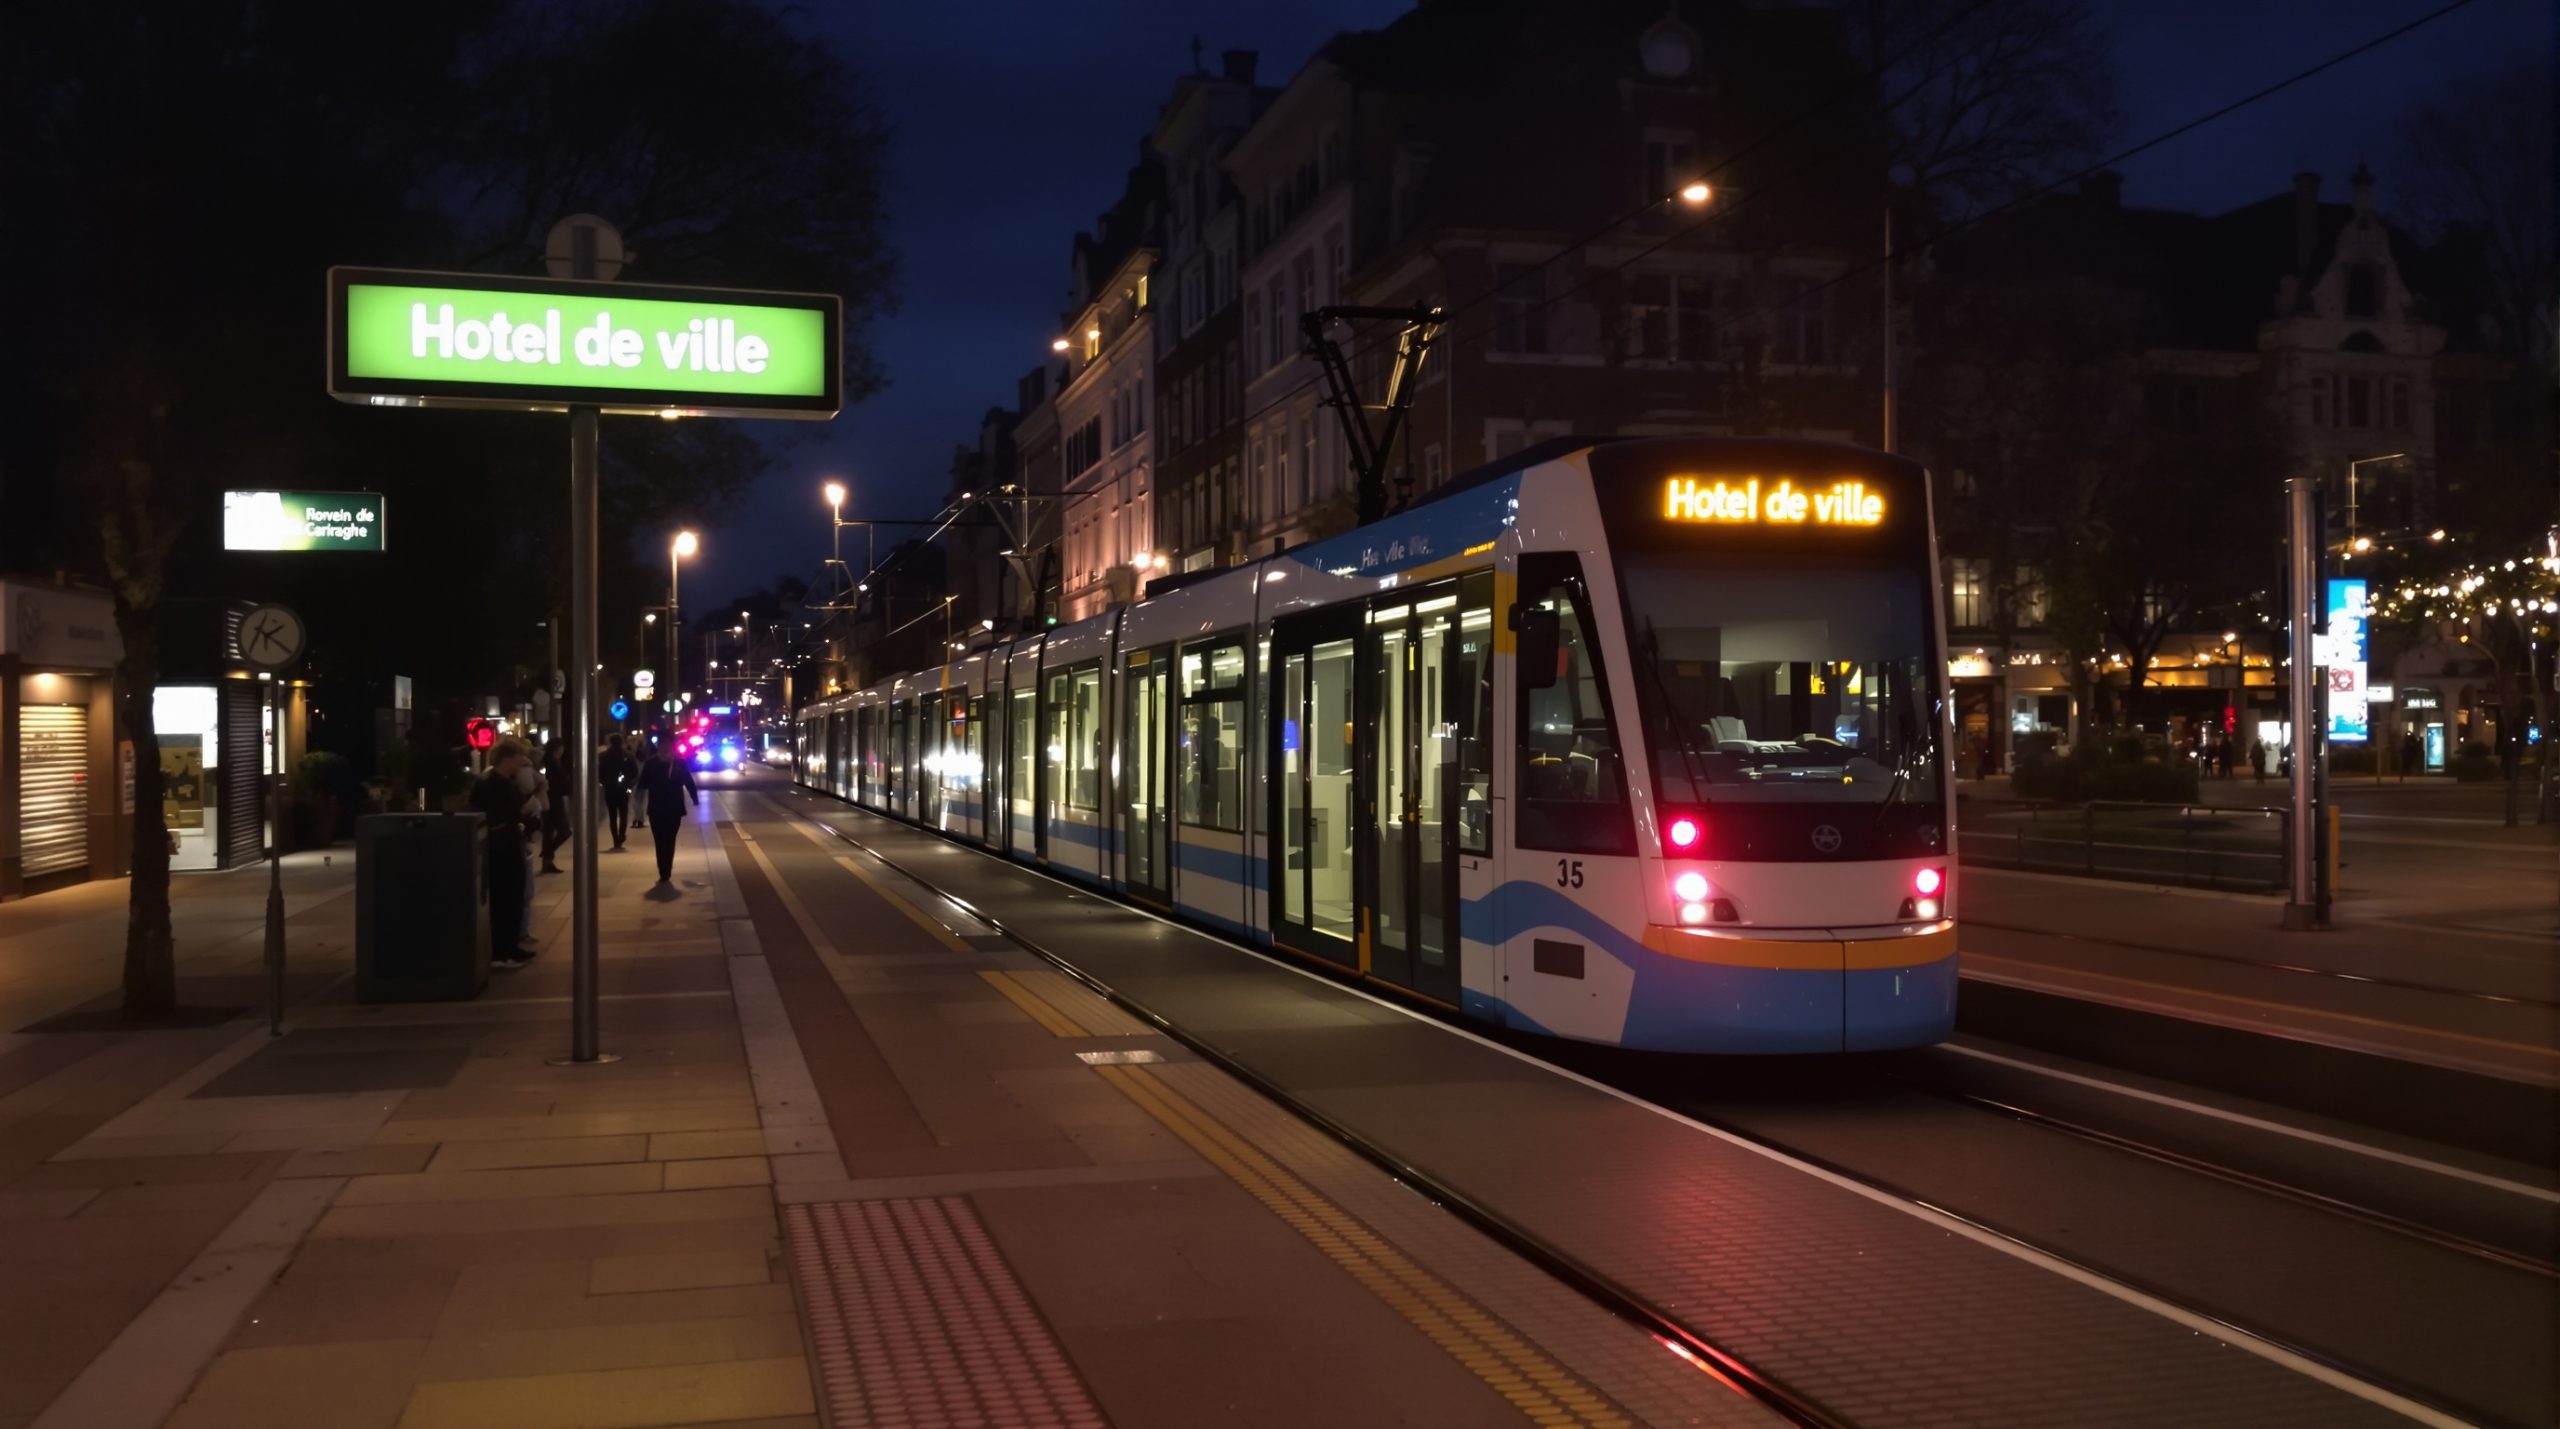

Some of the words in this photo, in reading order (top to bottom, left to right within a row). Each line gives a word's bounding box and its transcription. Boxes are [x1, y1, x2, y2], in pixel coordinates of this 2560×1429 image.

[412, 303, 561, 365] Hotel
[574, 312, 644, 368] de
[656, 318, 769, 374] ville
[1664, 478, 1759, 521] Hotel
[1765, 481, 1810, 522] de
[1813, 483, 1884, 524] ville
[1557, 858, 1584, 889] 35
